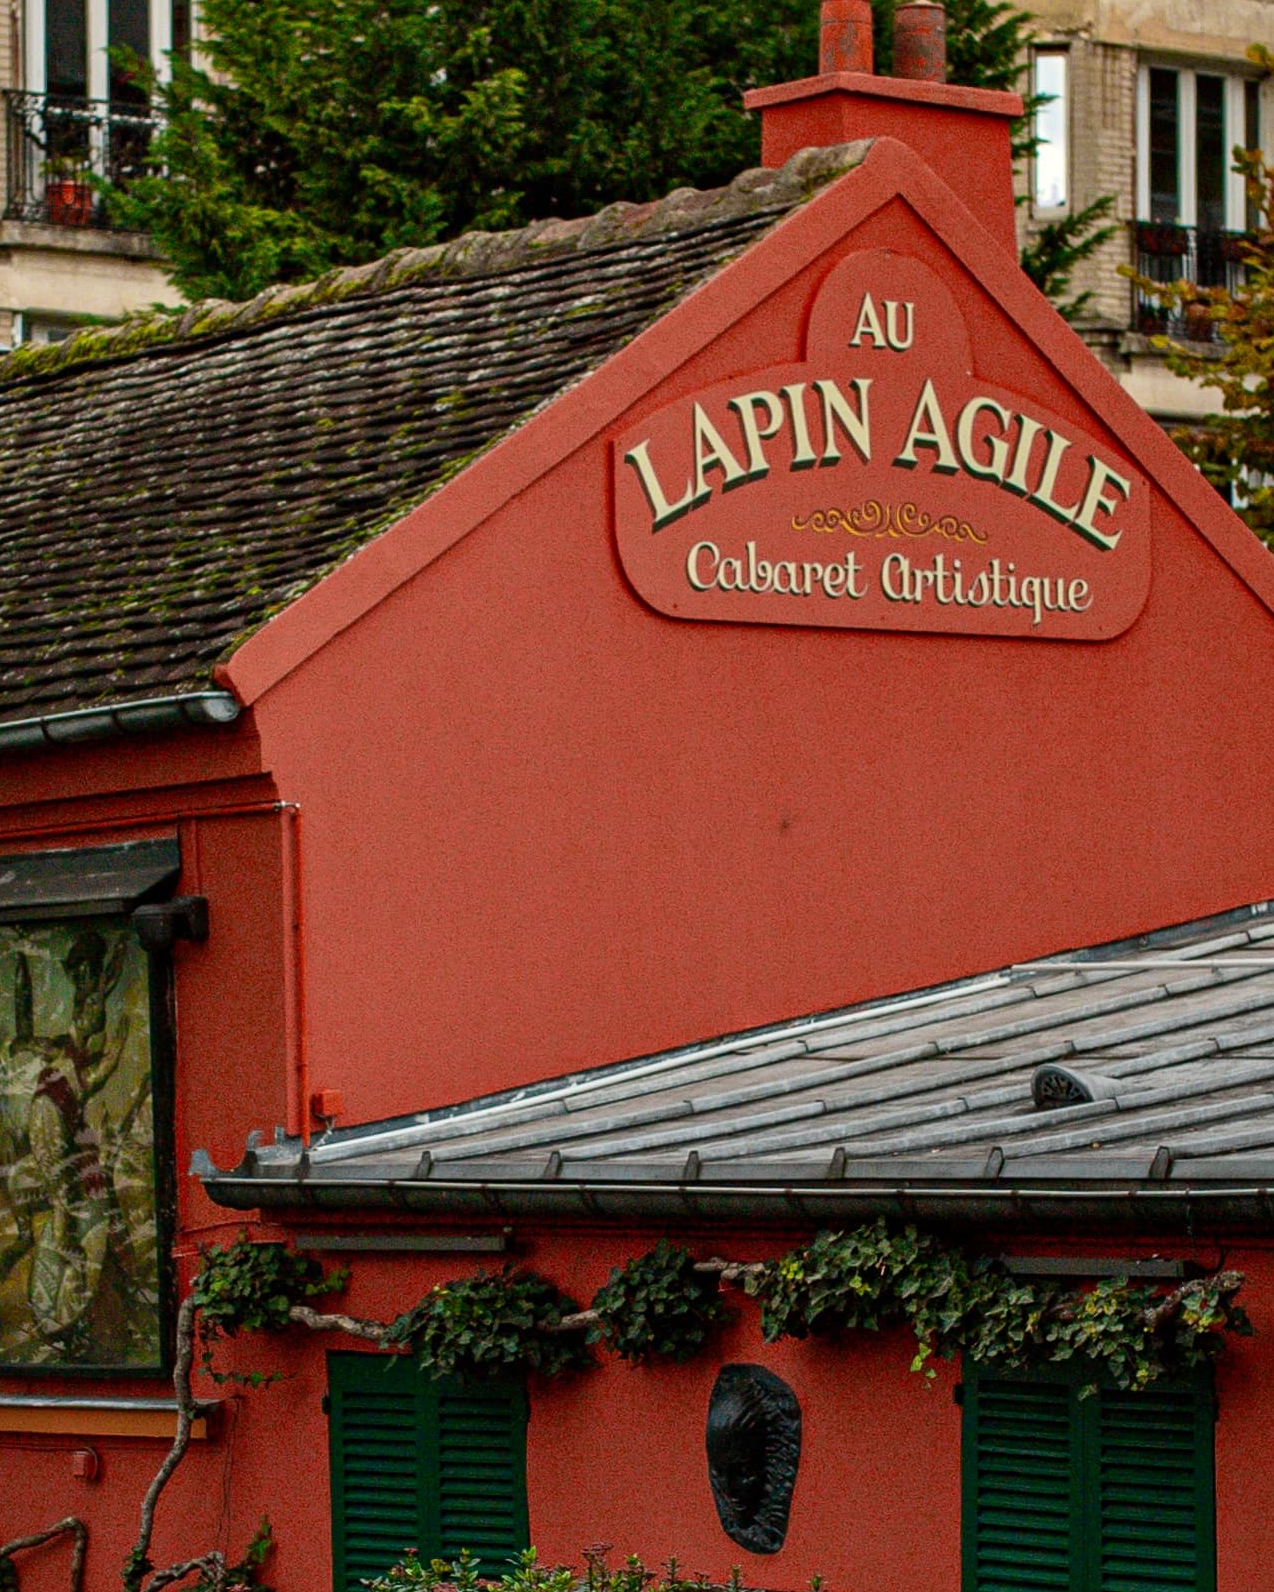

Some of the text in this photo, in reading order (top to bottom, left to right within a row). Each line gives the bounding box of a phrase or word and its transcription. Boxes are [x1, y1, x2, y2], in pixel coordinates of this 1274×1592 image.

[849, 292, 914, 350] AU
[625, 378, 1131, 551] LAPIN AGILE
[686, 541, 1094, 626] Cabaret Artistique
